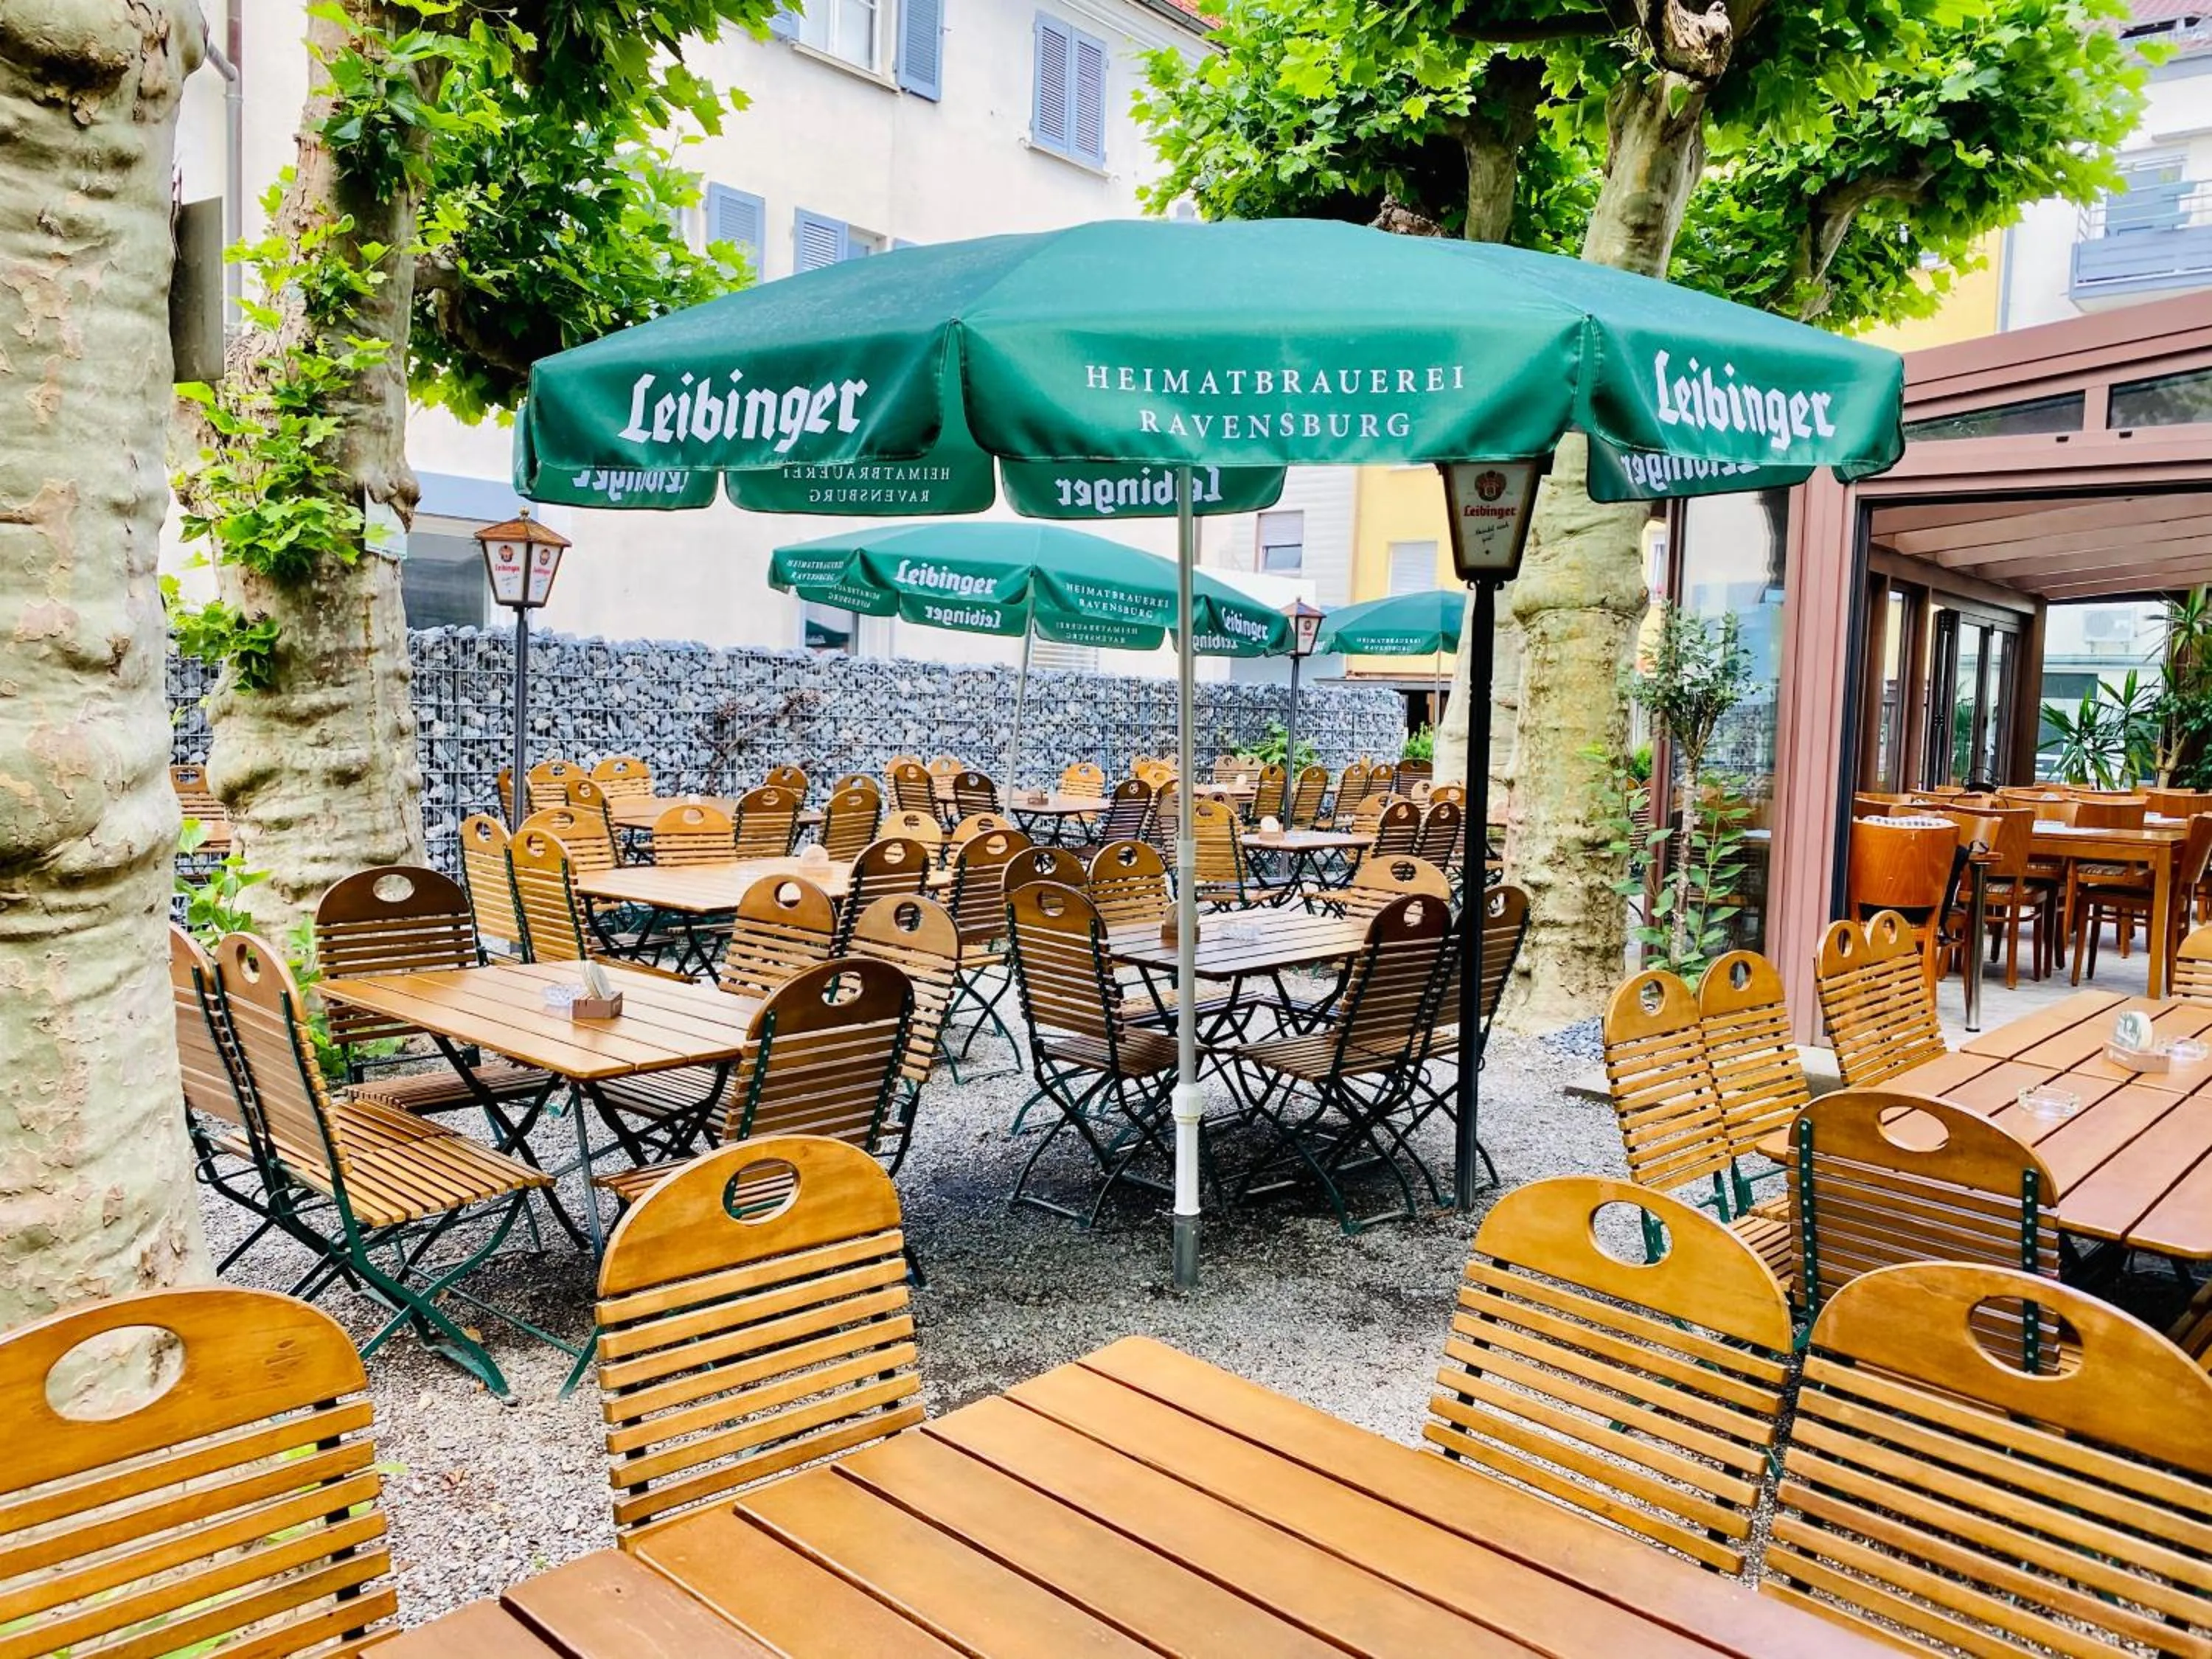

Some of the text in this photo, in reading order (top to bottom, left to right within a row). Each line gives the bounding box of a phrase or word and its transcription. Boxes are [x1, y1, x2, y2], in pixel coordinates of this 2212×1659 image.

[1085, 365, 1464, 394] HEIMATBRAUEREI
[618, 368, 869, 453] Leibinger
[1654, 349, 1836, 451] Leibinger
[1140, 410, 1411, 439] RAVENSBURG
[1464, 504, 1517, 520] Leibinger
[894, 559, 998, 597] Leibinger
[1066, 582, 1169, 608] HEIMATBRAUEREI
[1079, 598, 1153, 619] RAVENSBURG
[1221, 607, 1269, 641] Leibinger
